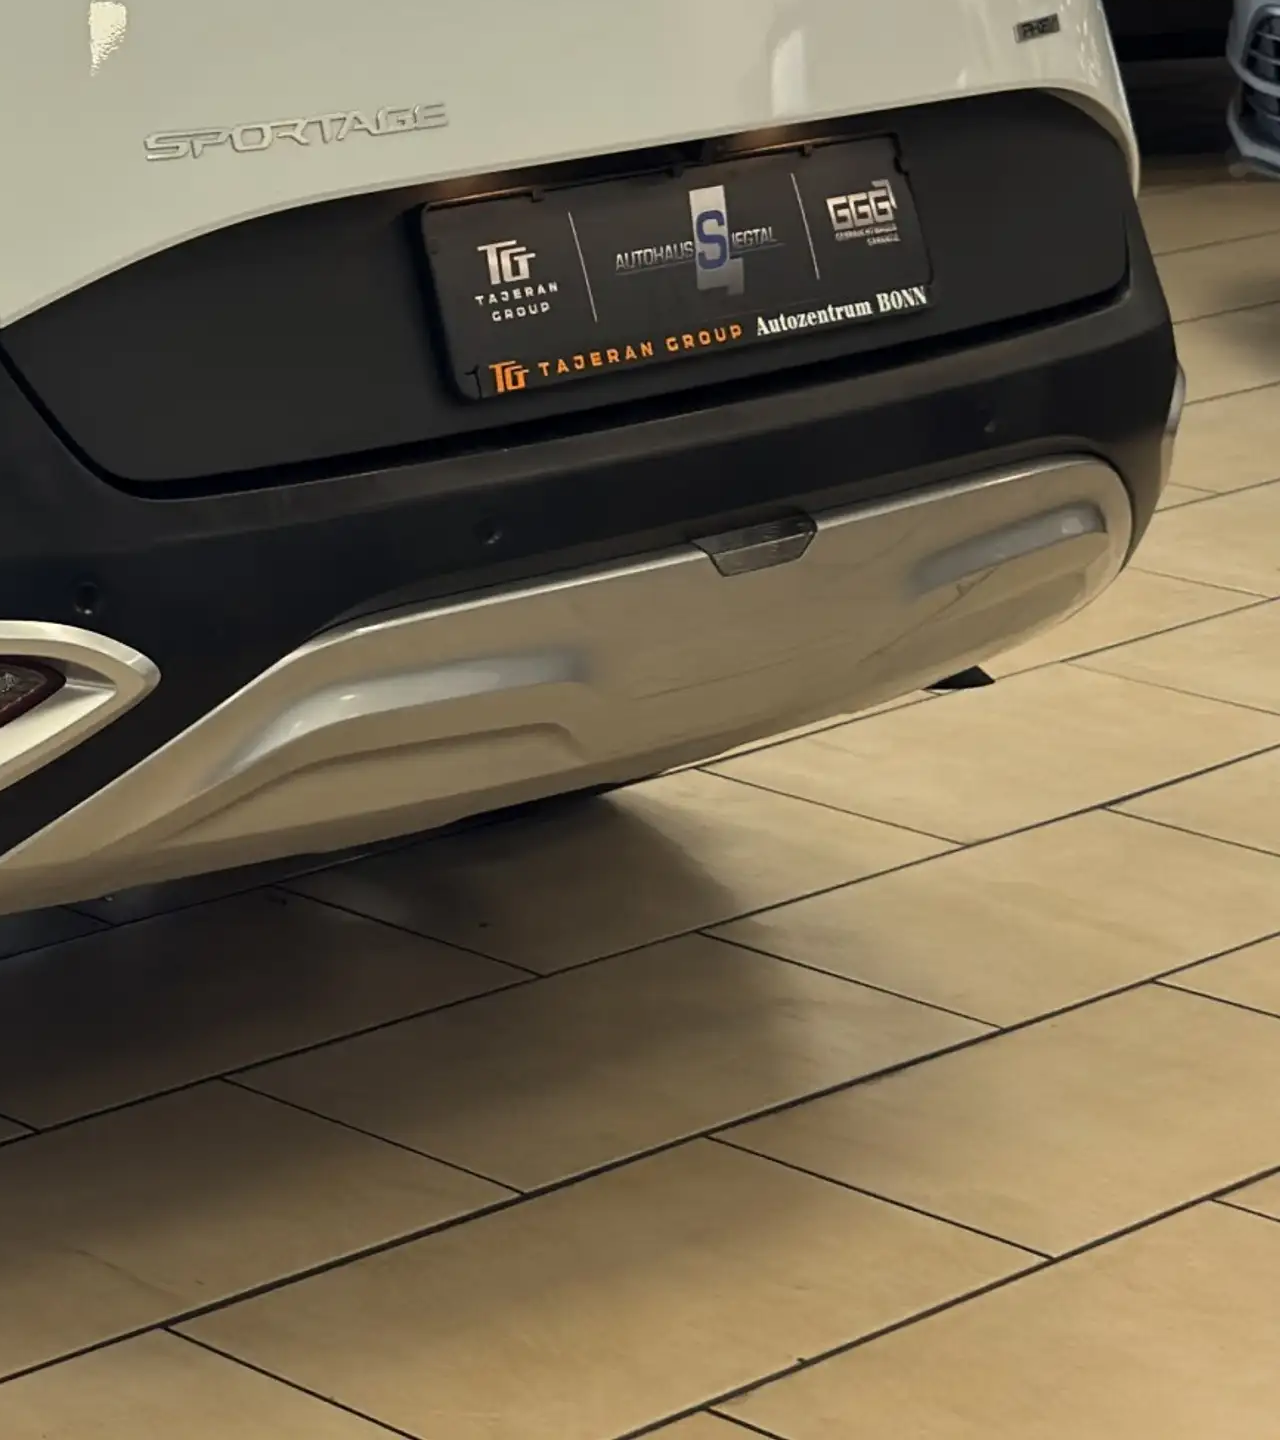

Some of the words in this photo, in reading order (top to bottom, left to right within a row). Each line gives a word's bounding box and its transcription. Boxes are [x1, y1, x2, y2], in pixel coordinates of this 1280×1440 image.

[143, 103, 449, 161] SPORTAGE
[615, 241, 694, 271] AUTOHAUS
[474, 281, 558, 306] TAJERAN
[491, 301, 550, 321] GROUP
[538, 341, 653, 377] TAJERAN
[665, 324, 742, 352] GROUP
[756, 299, 873, 336] Autozentrum
[876, 285, 928, 313] BONN
